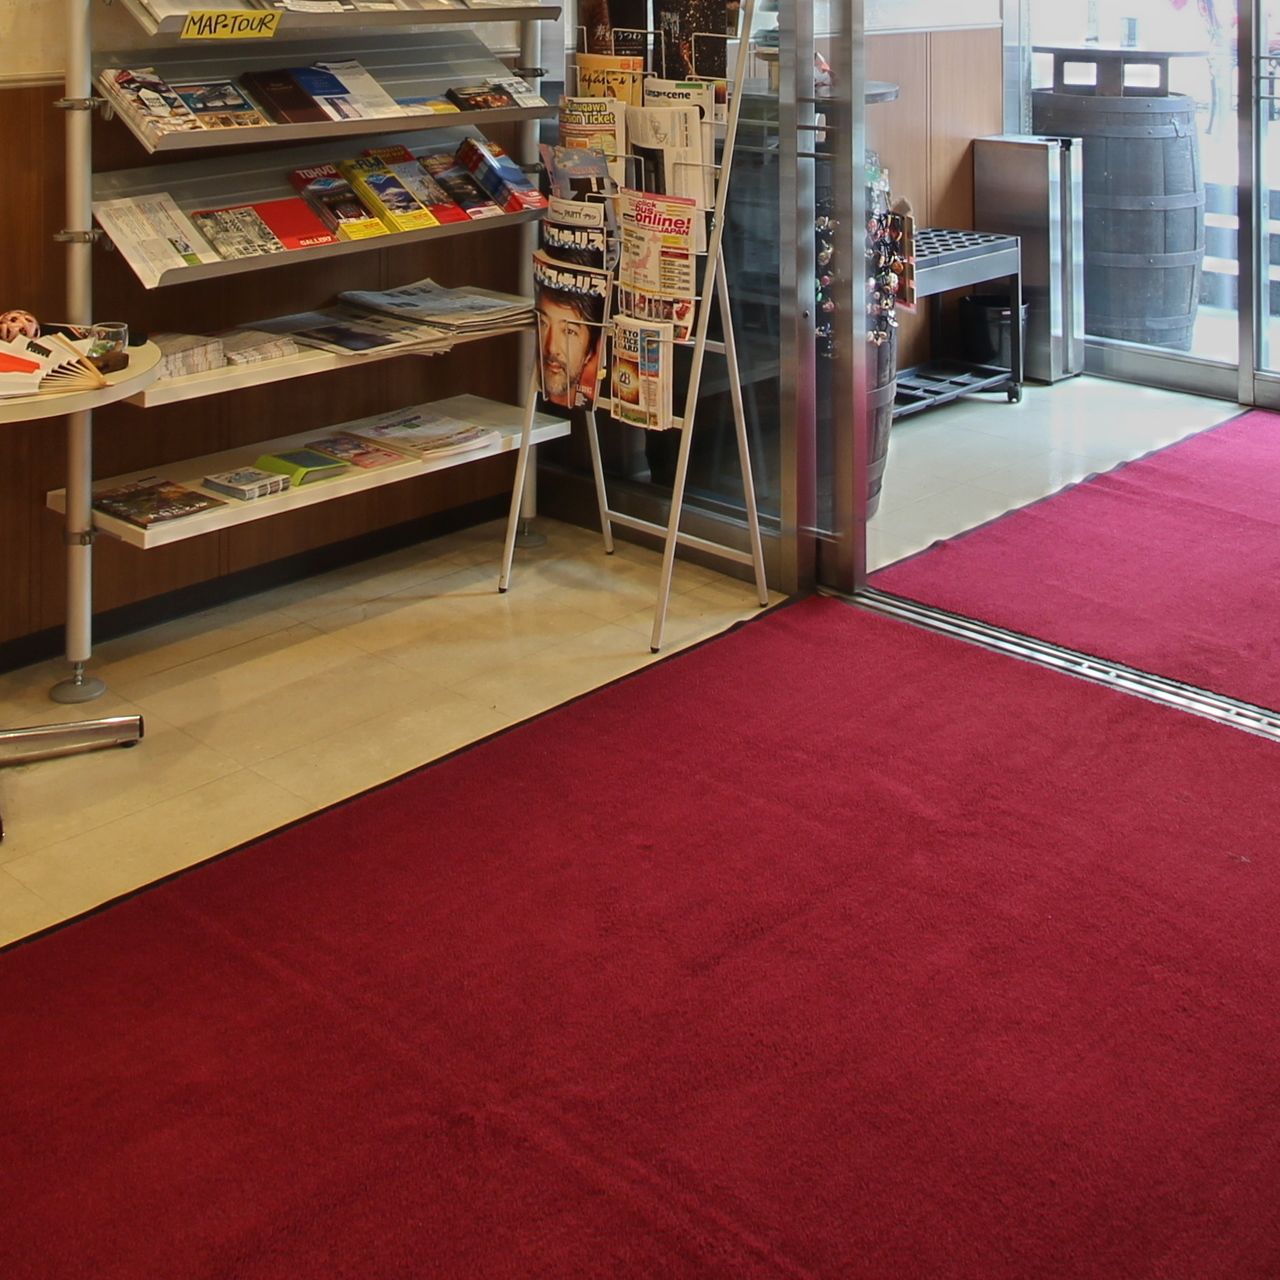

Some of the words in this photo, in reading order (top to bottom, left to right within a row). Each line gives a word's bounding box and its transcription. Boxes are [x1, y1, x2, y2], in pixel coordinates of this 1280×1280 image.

[584, 112, 616, 125] Ticket
[635, 205, 654, 215] bus
[635, 213, 691, 229] online!
[659, 227, 690, 236] JAPAN
